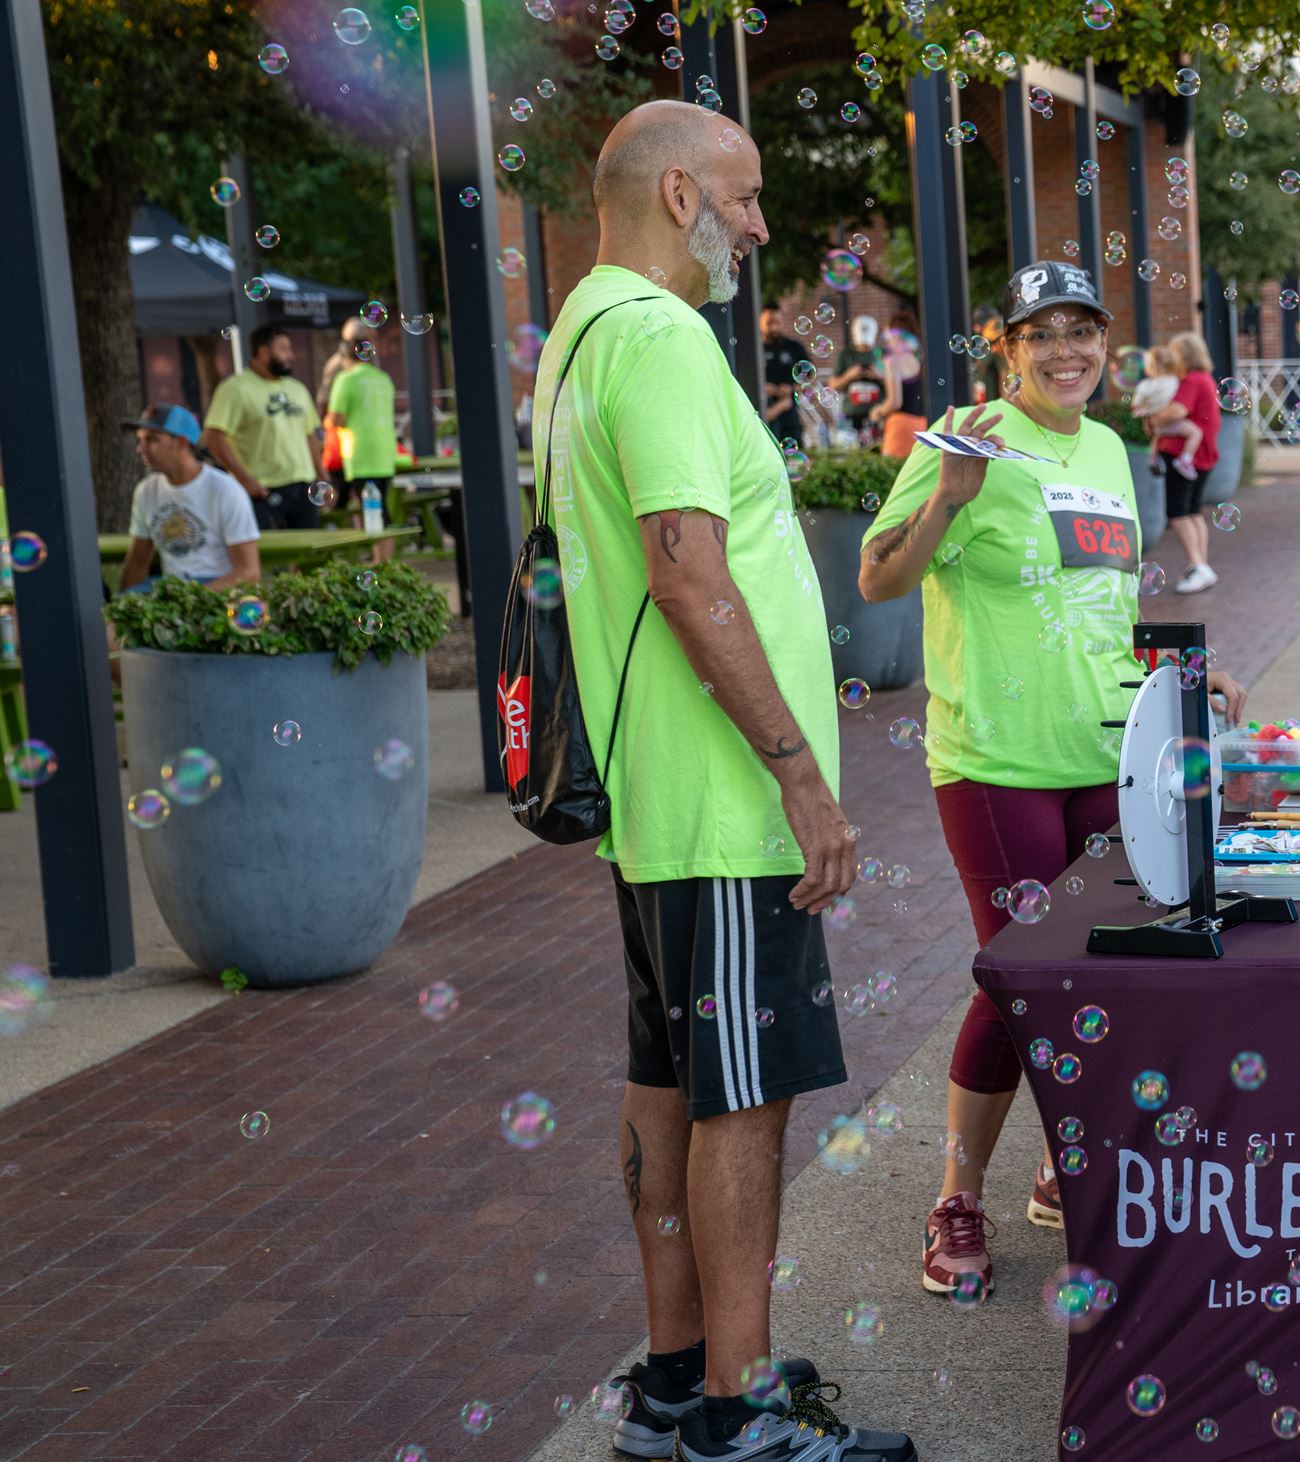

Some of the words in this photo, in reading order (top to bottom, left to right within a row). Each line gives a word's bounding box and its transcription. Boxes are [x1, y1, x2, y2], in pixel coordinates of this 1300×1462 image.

[1050, 492, 1074, 501] 2025
[1073, 518, 1131, 559] 625
[1020, 565, 1057, 587] 5K
[1176, 1129, 1227, 1147] THE
